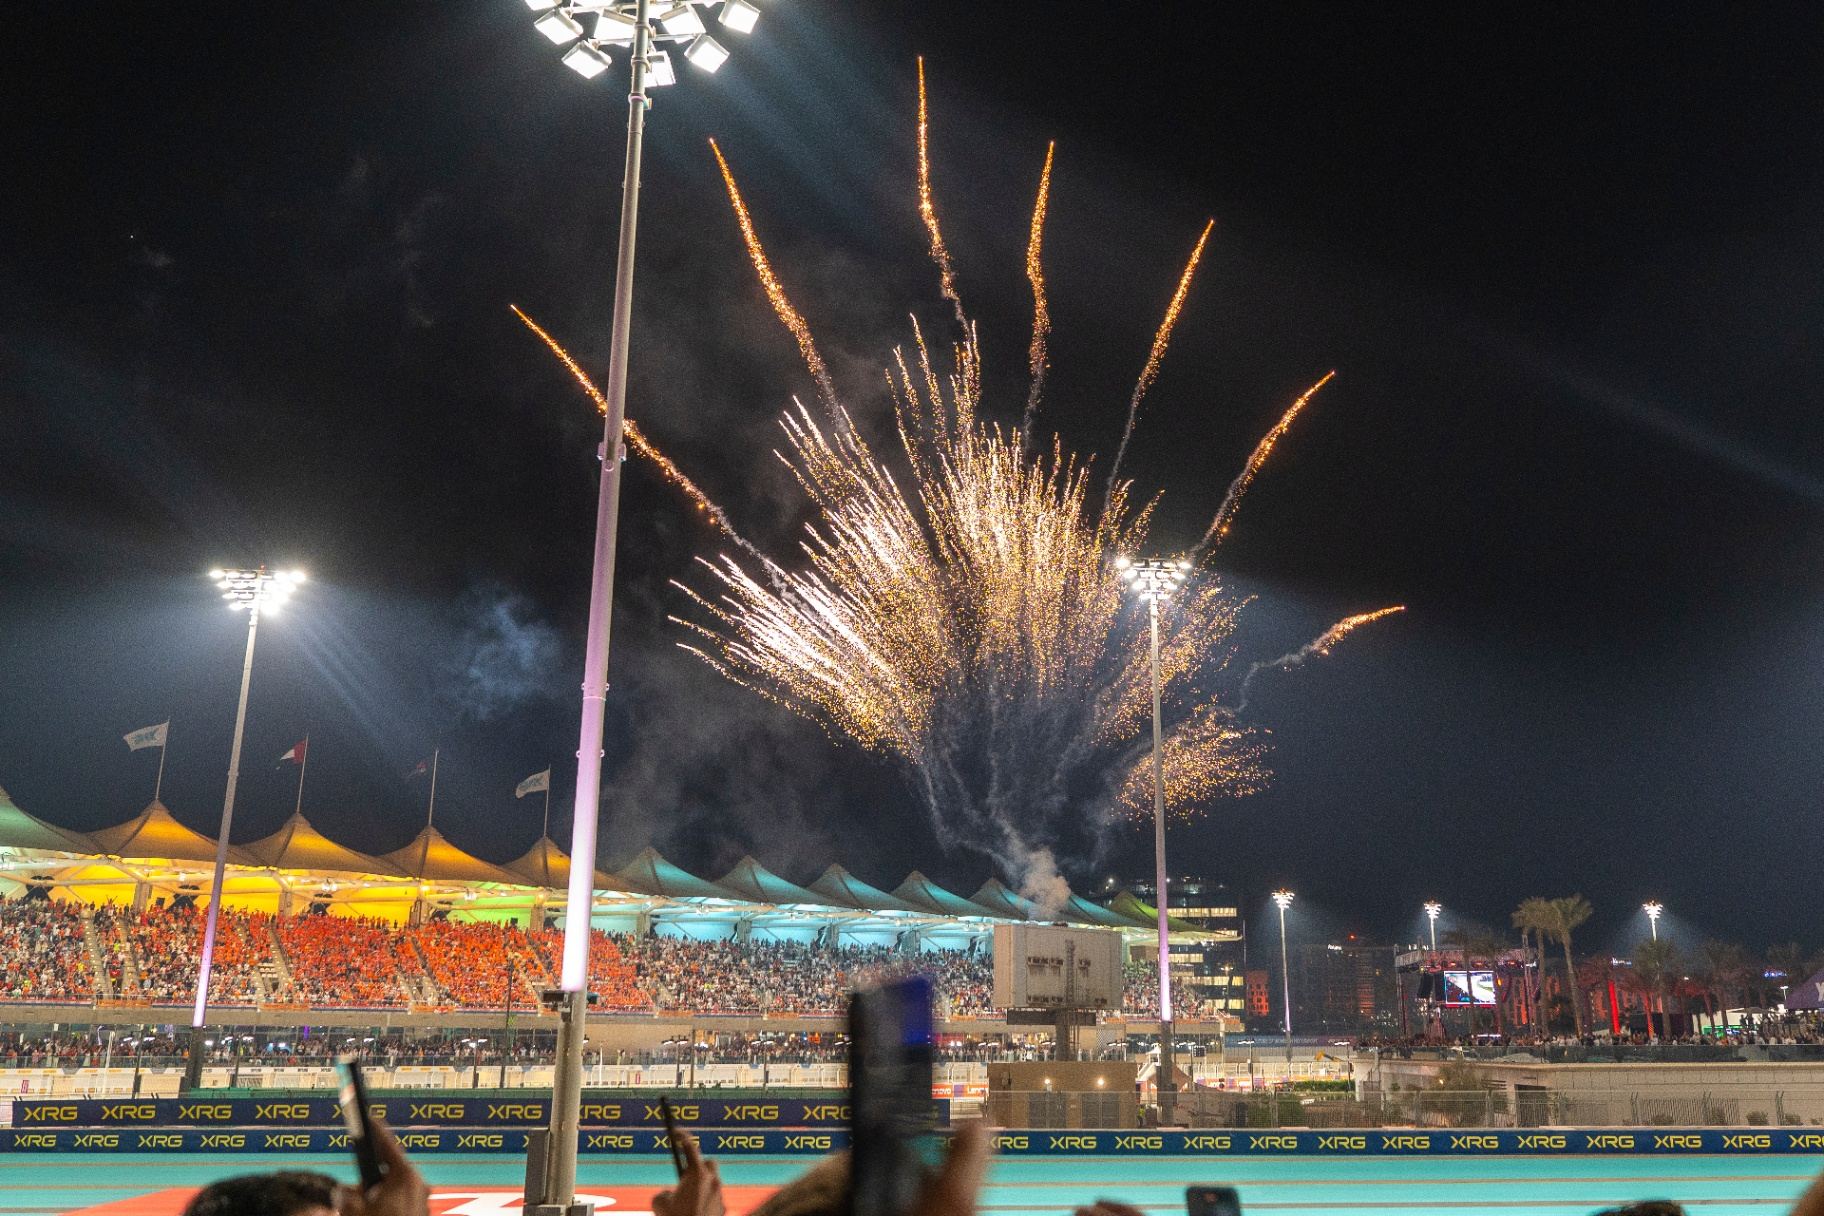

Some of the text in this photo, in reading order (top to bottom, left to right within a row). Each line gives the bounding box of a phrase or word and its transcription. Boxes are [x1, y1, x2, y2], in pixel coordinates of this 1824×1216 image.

[24, 1106, 78, 1120] XRG
[101, 1105, 156, 1119] XRG
[178, 1105, 232, 1119] XRG
[255, 1105, 310, 1119] XRG
[332, 1105, 387, 1119] XG
[410, 1105, 464, 1119] XRG
[488, 1105, 542, 1119] XRG
[723, 1105, 779, 1120] XRG
[14, 1134, 57, 1147] XRG
[74, 1134, 119, 1147] XRG
[138, 1135, 183, 1147] XRG
[200, 1135, 245, 1147] XRG
[265, 1135, 310, 1147] XRG
[457, 1135, 503, 1147] XRG
[587, 1135, 634, 1148] XRG
[717, 1136, 765, 1148] XRG
[785, 1136, 831, 1149] XRG
[1050, 1136, 1097, 1149] XRG
[1115, 1136, 1163, 1149] XRG
[1184, 1136, 1231, 1149] XRG
[1250, 1136, 1298, 1149] XRG
[1318, 1136, 1366, 1149] XRG
[1382, 1136, 1430, 1149] XRG
[1451, 1136, 1499, 1149] XRG
[1517, 1135, 1567, 1148] XRG
[1586, 1135, 1635, 1149] XRG
[1654, 1135, 1702, 1148] XRG
[1722, 1135, 1771, 1148] XRG
[1789, 1135, 1824, 1148] XR
